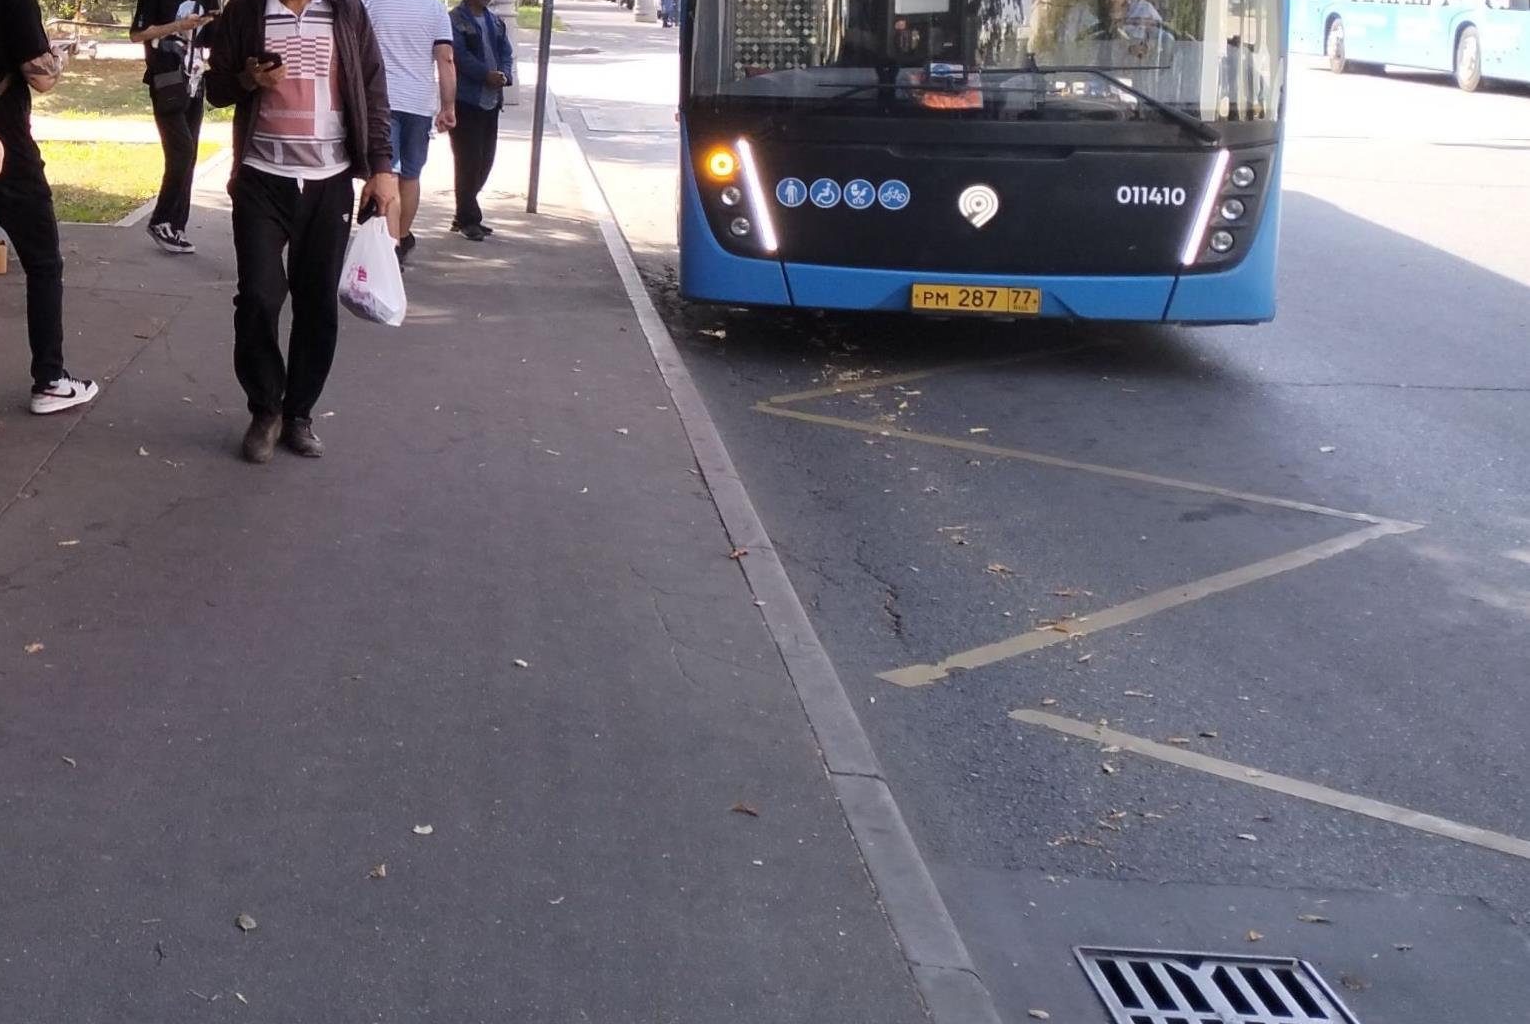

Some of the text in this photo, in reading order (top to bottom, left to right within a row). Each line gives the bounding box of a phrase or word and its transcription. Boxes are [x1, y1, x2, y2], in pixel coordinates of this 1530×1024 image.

[1116, 185, 1186, 206] 011410
[958, 289, 997, 308] 287
[1011, 290, 1031, 305] 77
